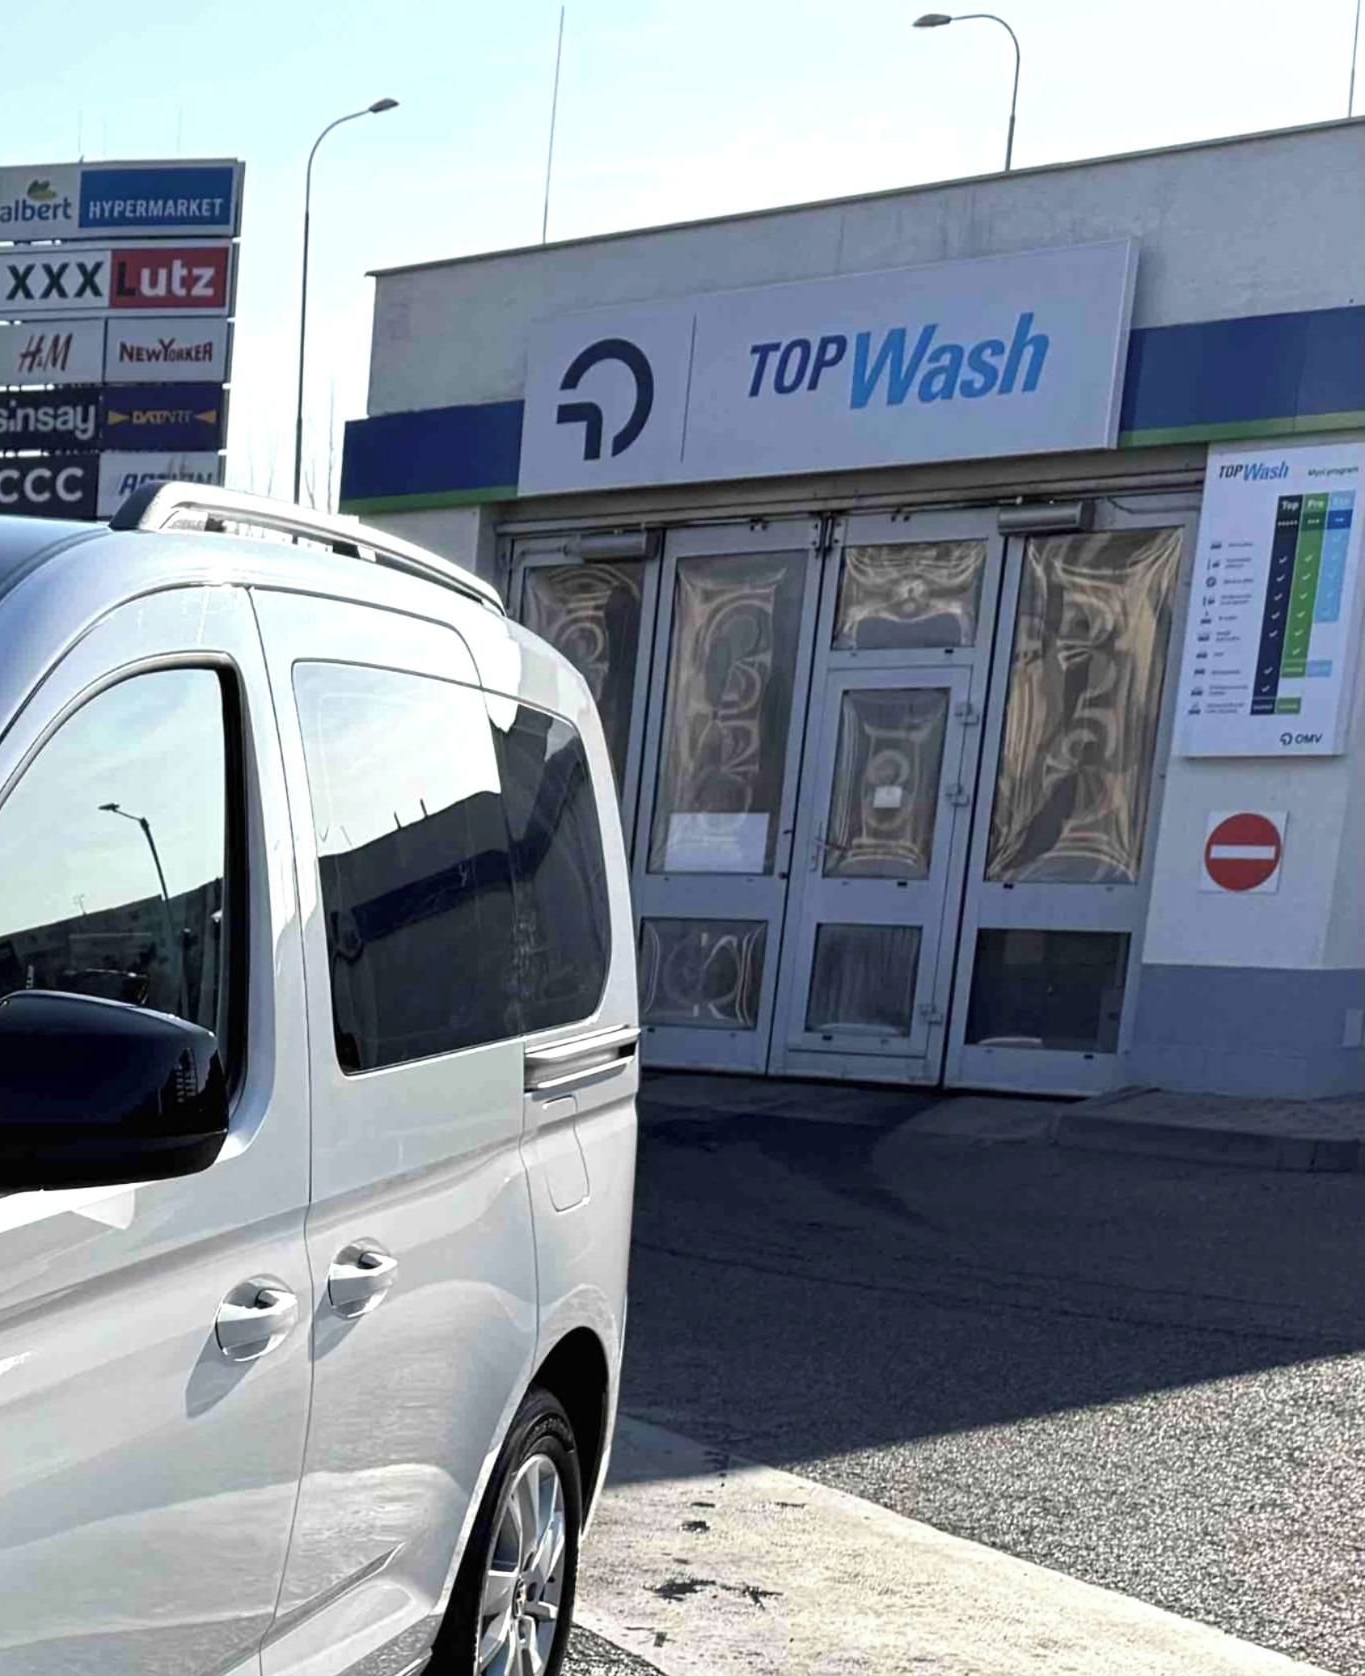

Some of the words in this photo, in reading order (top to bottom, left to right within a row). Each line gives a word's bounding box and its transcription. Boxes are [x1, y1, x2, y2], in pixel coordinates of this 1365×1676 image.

[0, 197, 72, 223] albert
[89, 198, 223, 221] HYPERMARKET
[18, 332, 73, 374] H&M
[1295, 733, 1323, 745] OMV
